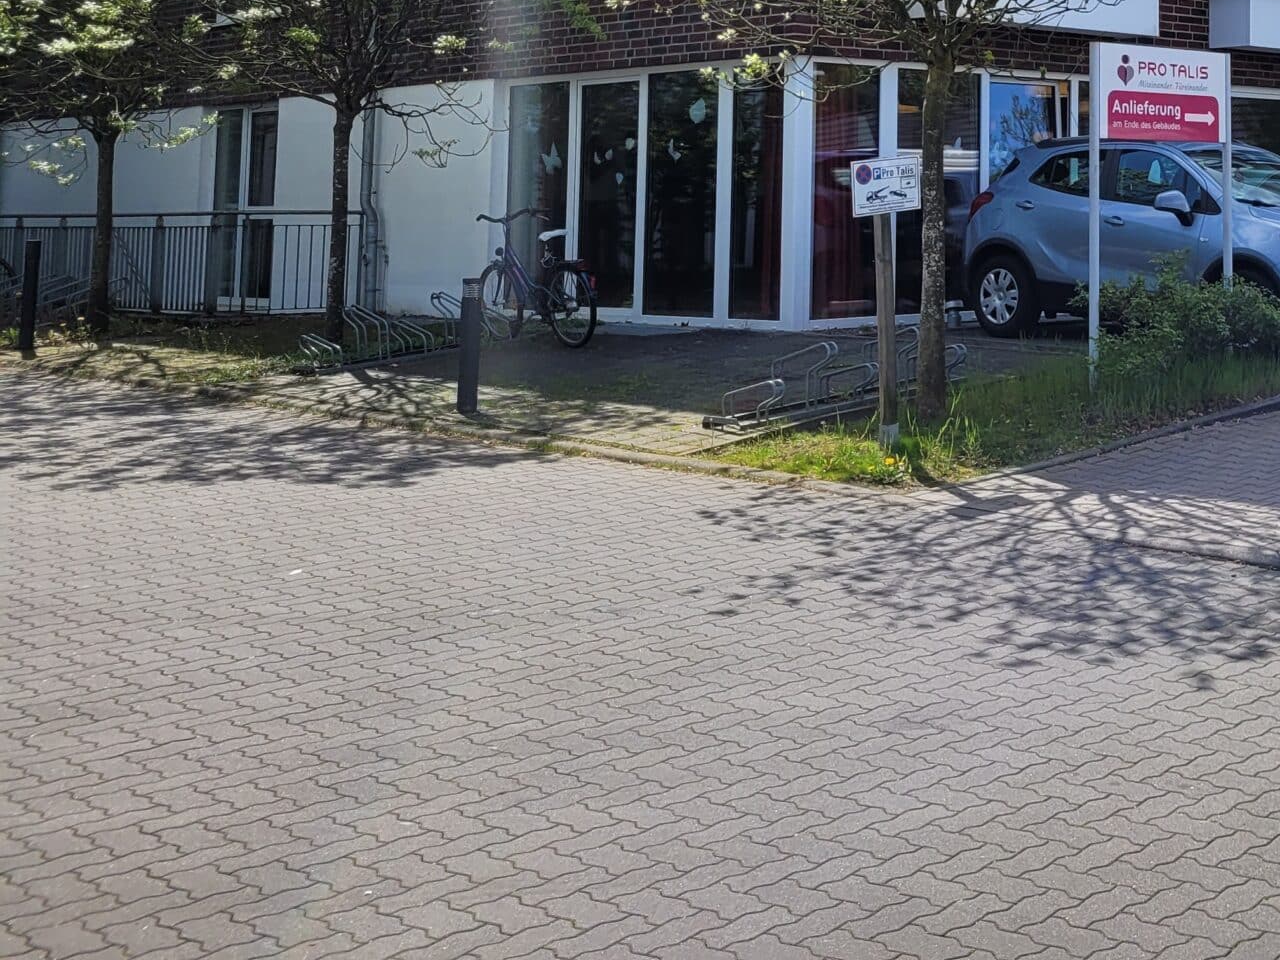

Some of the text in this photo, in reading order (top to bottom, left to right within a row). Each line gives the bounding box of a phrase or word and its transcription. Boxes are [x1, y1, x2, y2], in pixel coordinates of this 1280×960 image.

[1138, 61, 1209, 80] PRO TALIS
[1112, 99, 1181, 120] Anlieferung
[1124, 120, 1139, 129] Ende
[1141, 121, 1151, 130] des
[1153, 121, 1181, 130] Gebäudes
[882, 168, 894, 177] Pro
[896, 166, 914, 176] Talis
